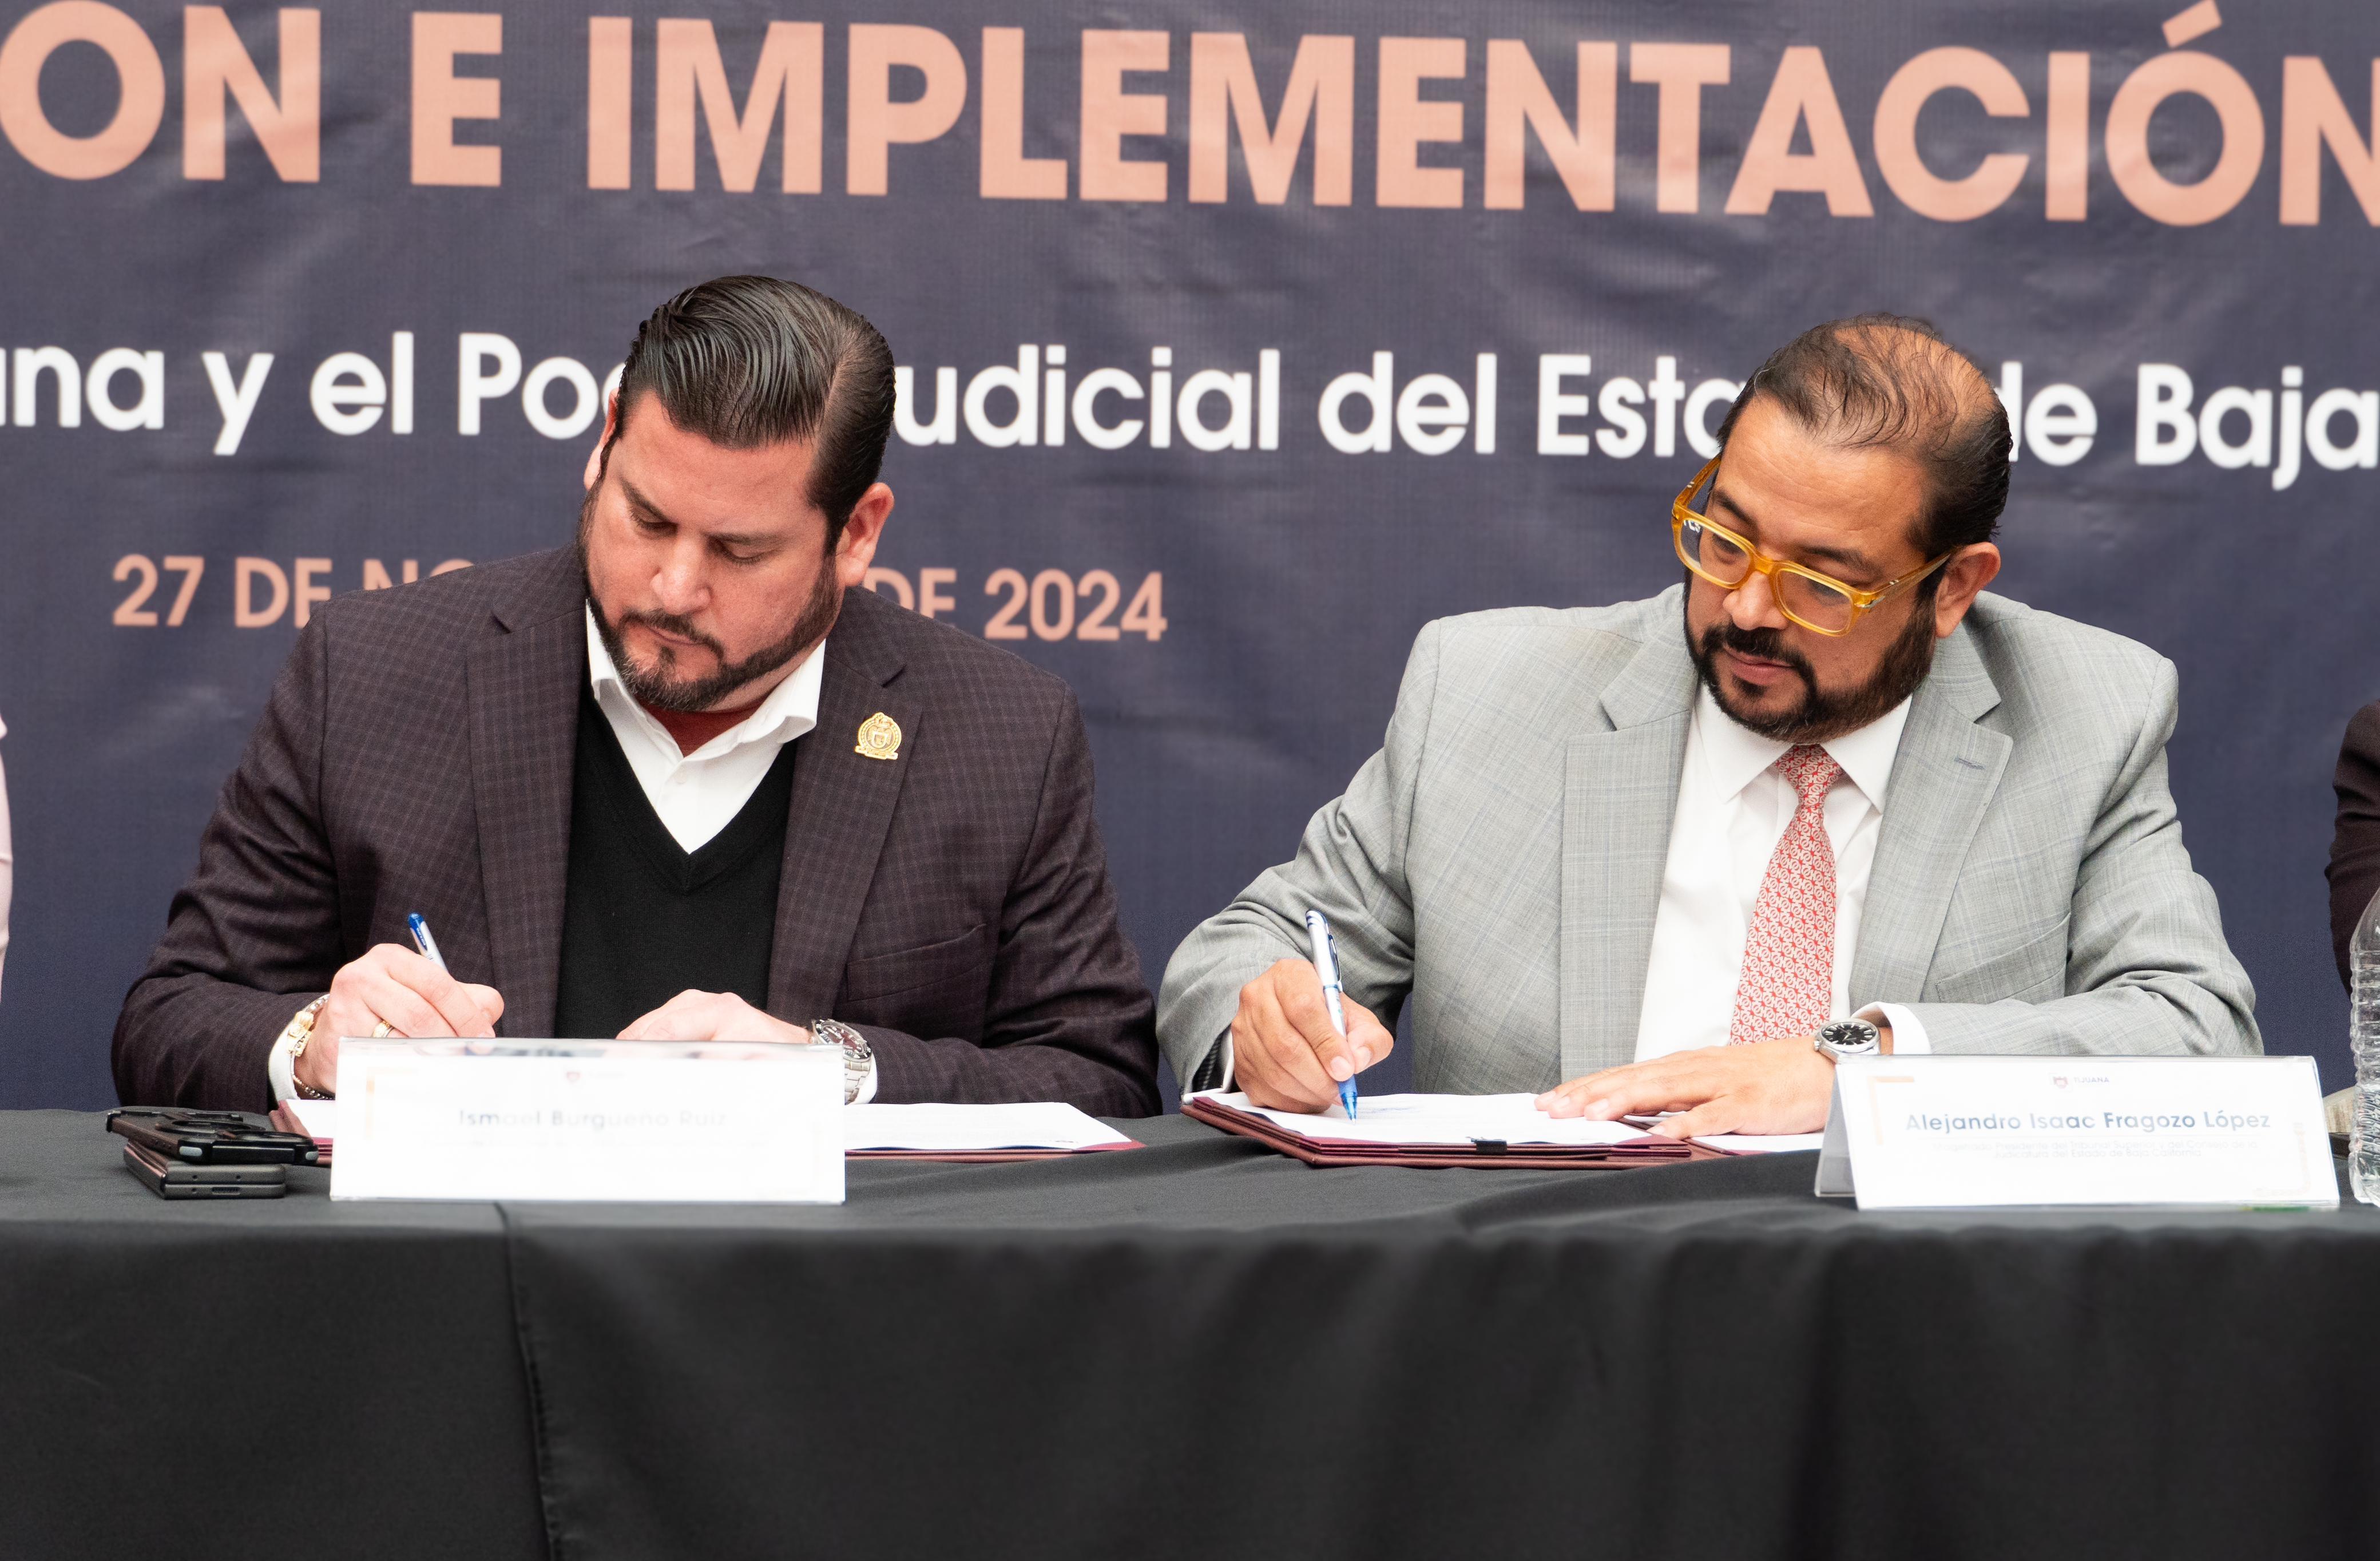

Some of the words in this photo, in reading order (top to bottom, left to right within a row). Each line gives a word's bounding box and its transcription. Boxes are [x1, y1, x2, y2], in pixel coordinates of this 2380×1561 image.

[411, 11, 503, 187] E
[588, 0, 2380, 227] IMPLEMENTACIÓN
[0, 346, 164, 431] na
[202, 351, 274, 455] y
[310, 331, 414, 435] el
[459, 332, 626, 439] Po
[893, 344, 1280, 451] udicial
[1318, 351, 1497, 455] del
[1537, 354, 1746, 459] Esta
[2135, 363, 2380, 490] Baja
[113, 554, 204, 627] 27
[235, 557, 332, 629] DE
[984, 568, 1168, 641] 2024
[459, 1110, 541, 1126] Ismael
[680, 1110, 727, 1127] Ruiz
[1905, 1113, 2021, 1134] Alejandro
[2030, 1112, 2096, 1130] Isaac
[2104, 1112, 2196, 1133] Fragozo
[2204, 1110, 2271, 1132] López
